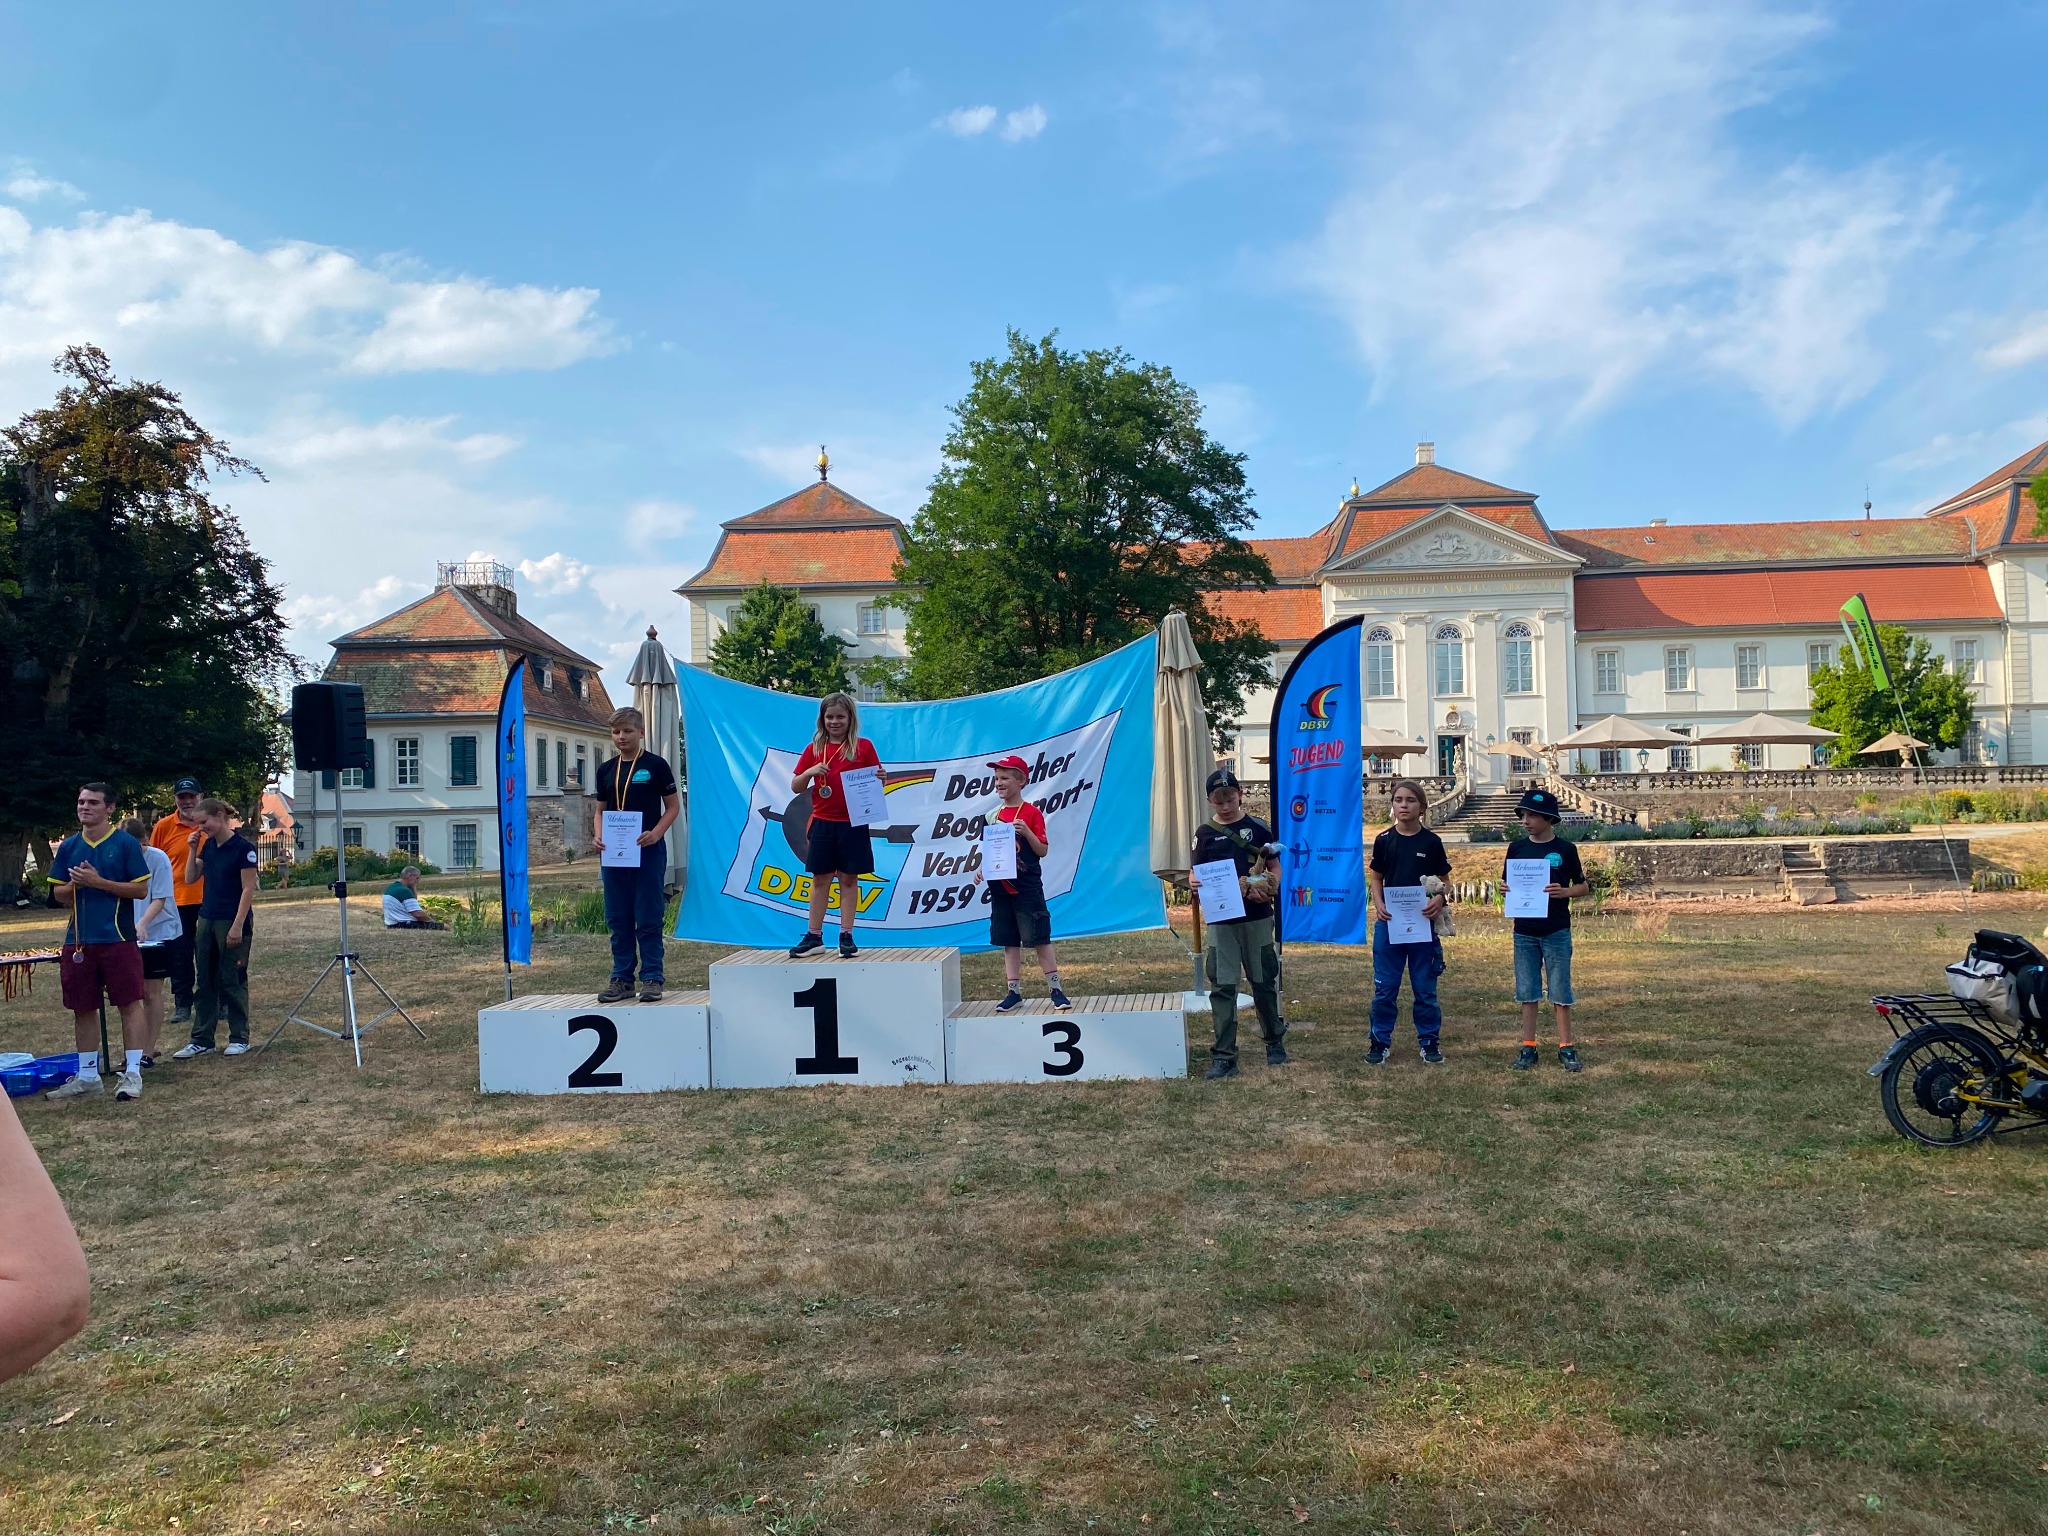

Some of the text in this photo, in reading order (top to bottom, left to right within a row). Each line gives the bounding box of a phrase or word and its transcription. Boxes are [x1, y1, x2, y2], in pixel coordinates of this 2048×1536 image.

[1299, 720, 1330, 730] DBSV
[1288, 739, 1345, 768] JUGEND
[943, 751, 1076, 801] Deuher
[922, 844, 983, 878] Verb
[758, 865, 885, 913] DBSV
[907, 884, 976, 915] 1959
[1389, 889, 1421, 899] Urkunde
[792, 977, 860, 1076] 1
[567, 1014, 623, 1089] 2
[1041, 1020, 1085, 1077] 3
